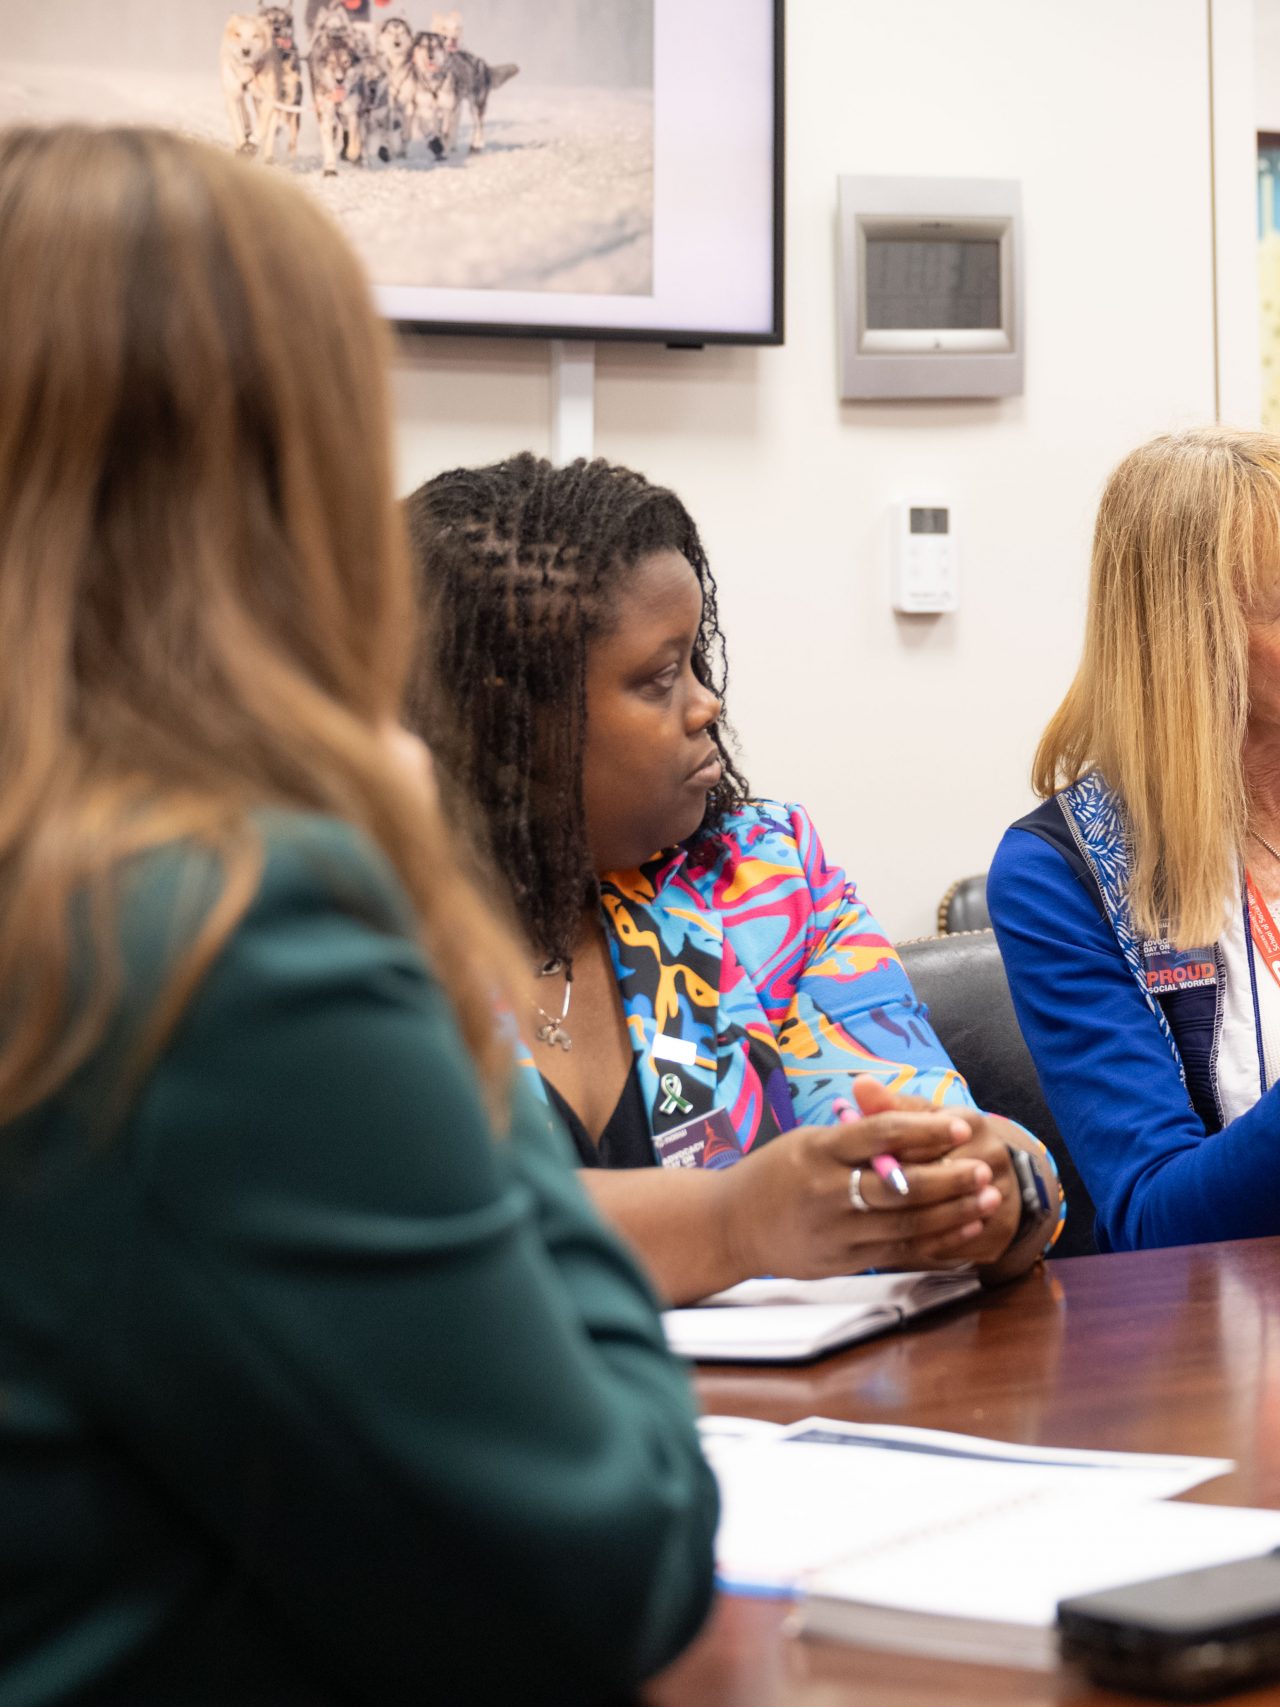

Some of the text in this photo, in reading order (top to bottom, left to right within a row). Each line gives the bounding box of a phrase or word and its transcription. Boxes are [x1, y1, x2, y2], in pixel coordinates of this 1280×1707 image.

[1254, 904, 1266, 925] Social
[1261, 921, 1271, 931] of
[1143, 943, 1170, 954] DAY ON
[1267, 930, 1280, 952] School
[1146, 963, 1215, 987] PROUD
[1149, 977, 1217, 994] SOCIAL WORKER
